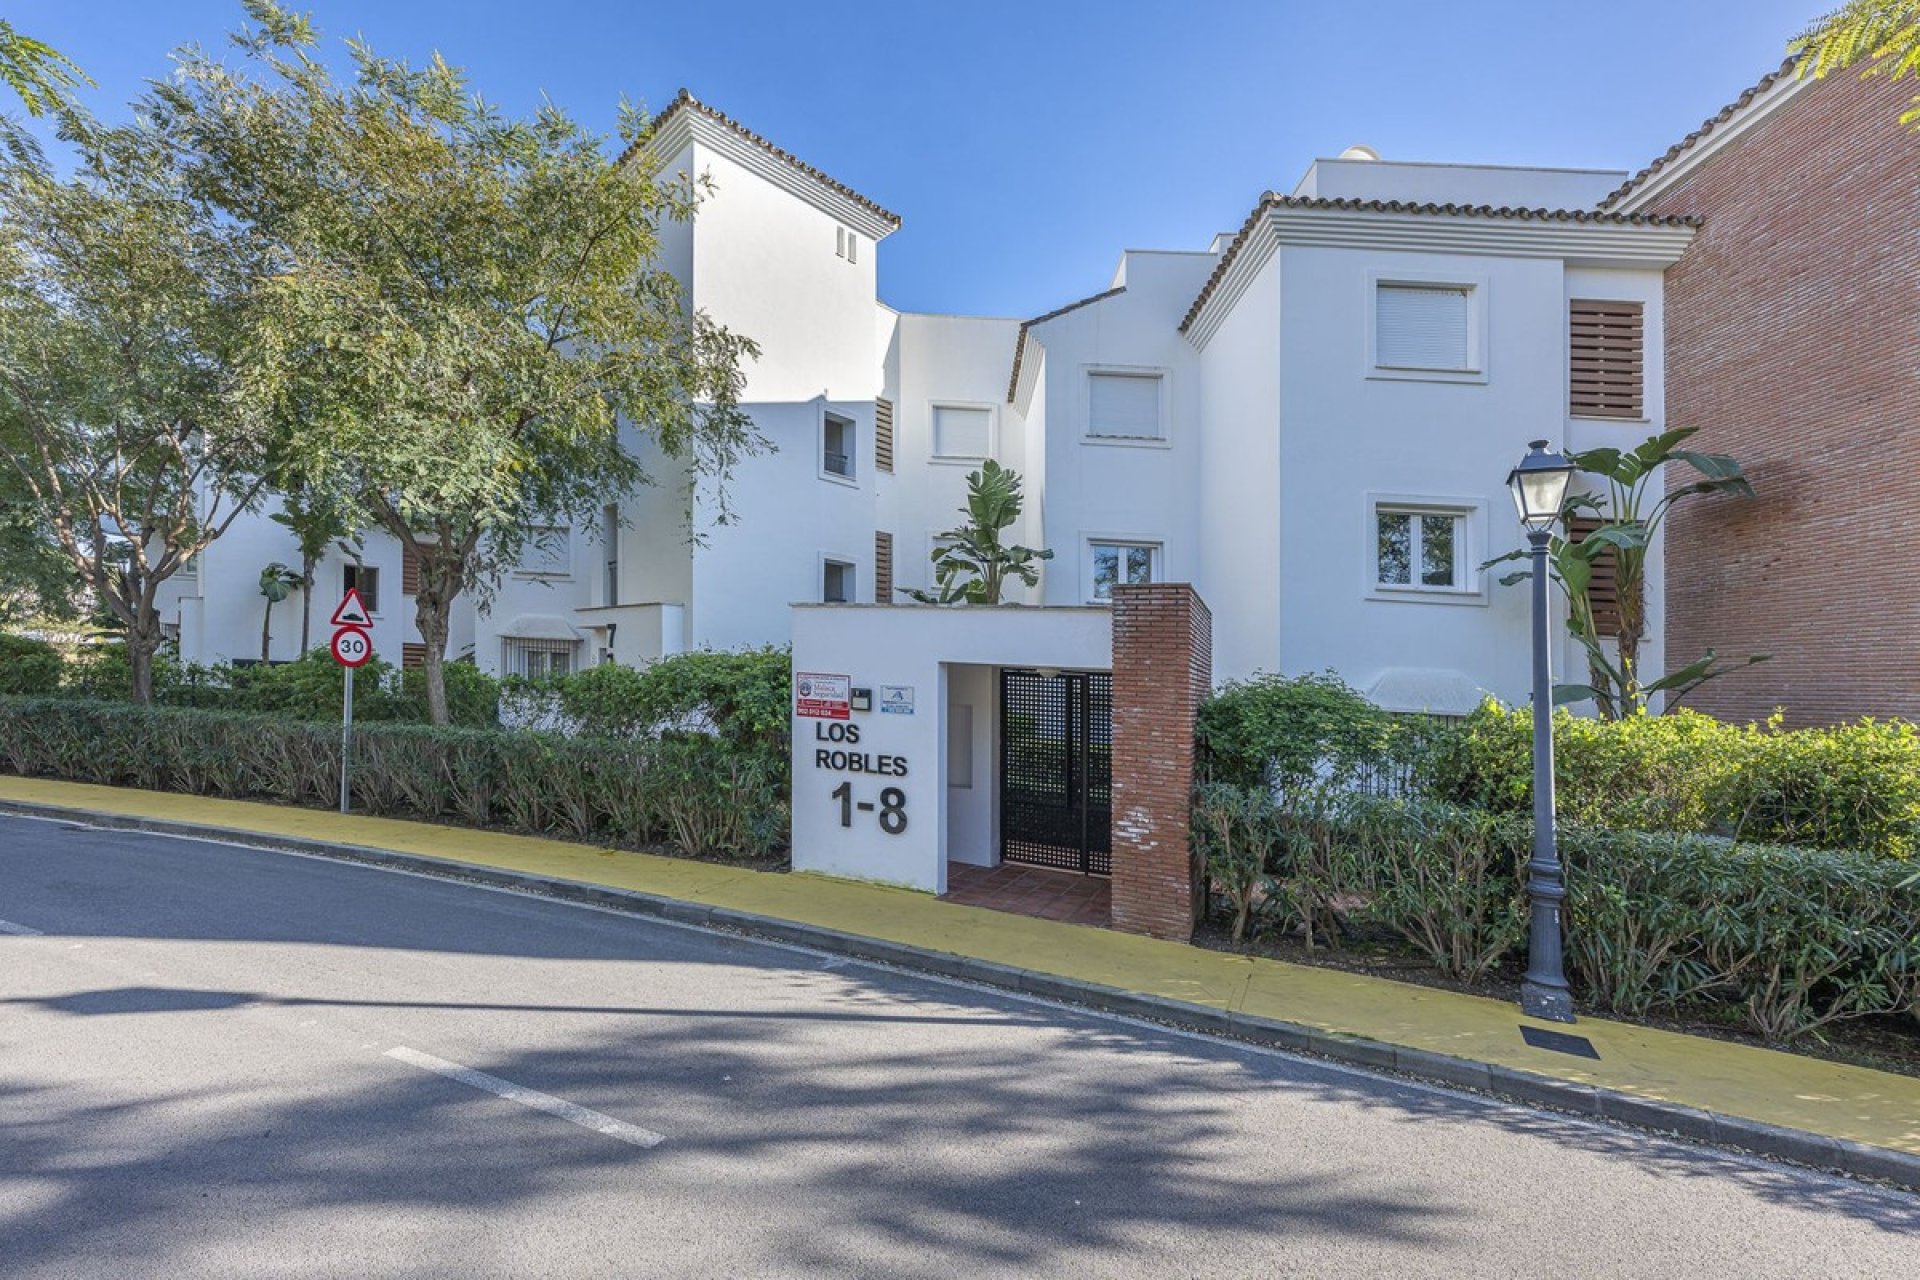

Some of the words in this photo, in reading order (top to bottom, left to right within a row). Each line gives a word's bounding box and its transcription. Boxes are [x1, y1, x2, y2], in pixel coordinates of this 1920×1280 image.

[341, 640, 364, 653] 30
[606, 624, 616, 648] 7
[816, 722, 860, 744] LOS
[815, 749, 908, 776] ROBLES
[832, 781, 908, 835] 1-8
